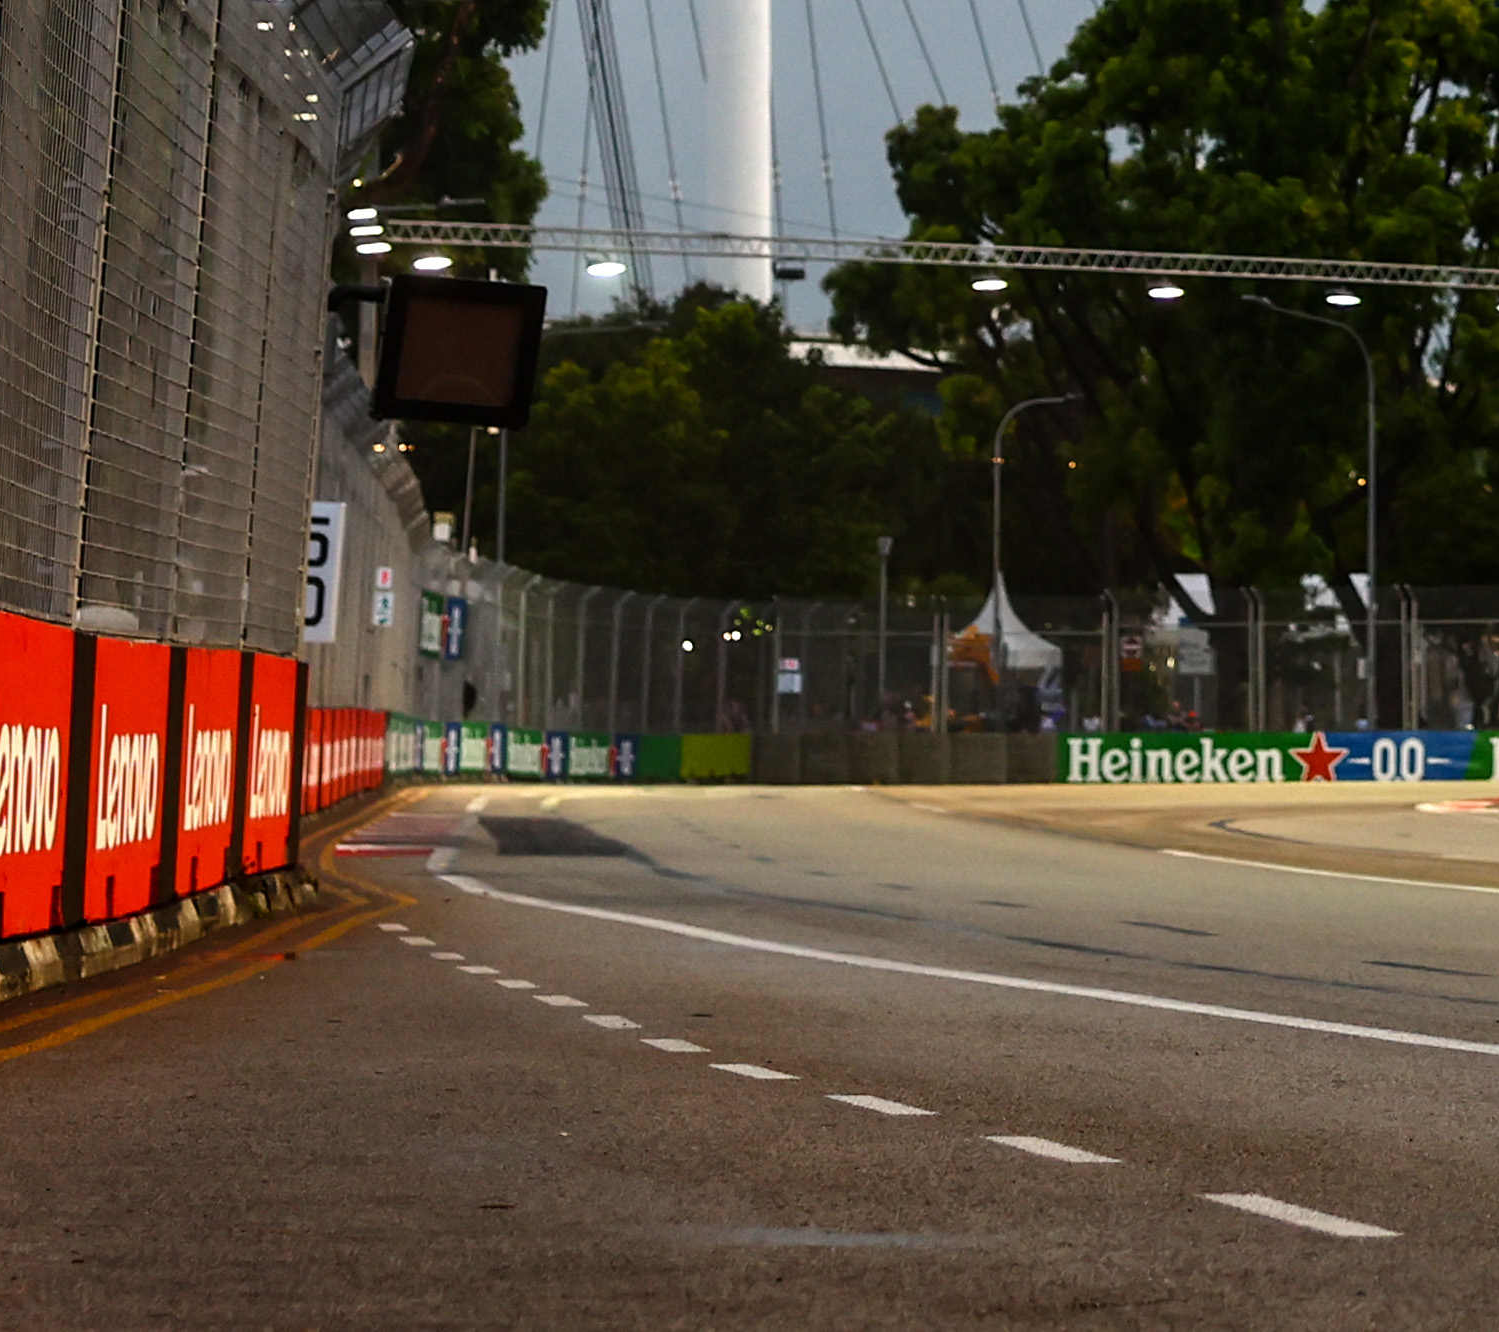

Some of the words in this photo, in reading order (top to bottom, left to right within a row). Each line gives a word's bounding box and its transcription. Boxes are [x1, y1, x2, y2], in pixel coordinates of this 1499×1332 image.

[95, 704, 159, 850] Lenovo
[183, 703, 232, 831] Lenovo
[249, 703, 291, 819] Lenovo
[1066, 737, 1285, 782] Heineken
